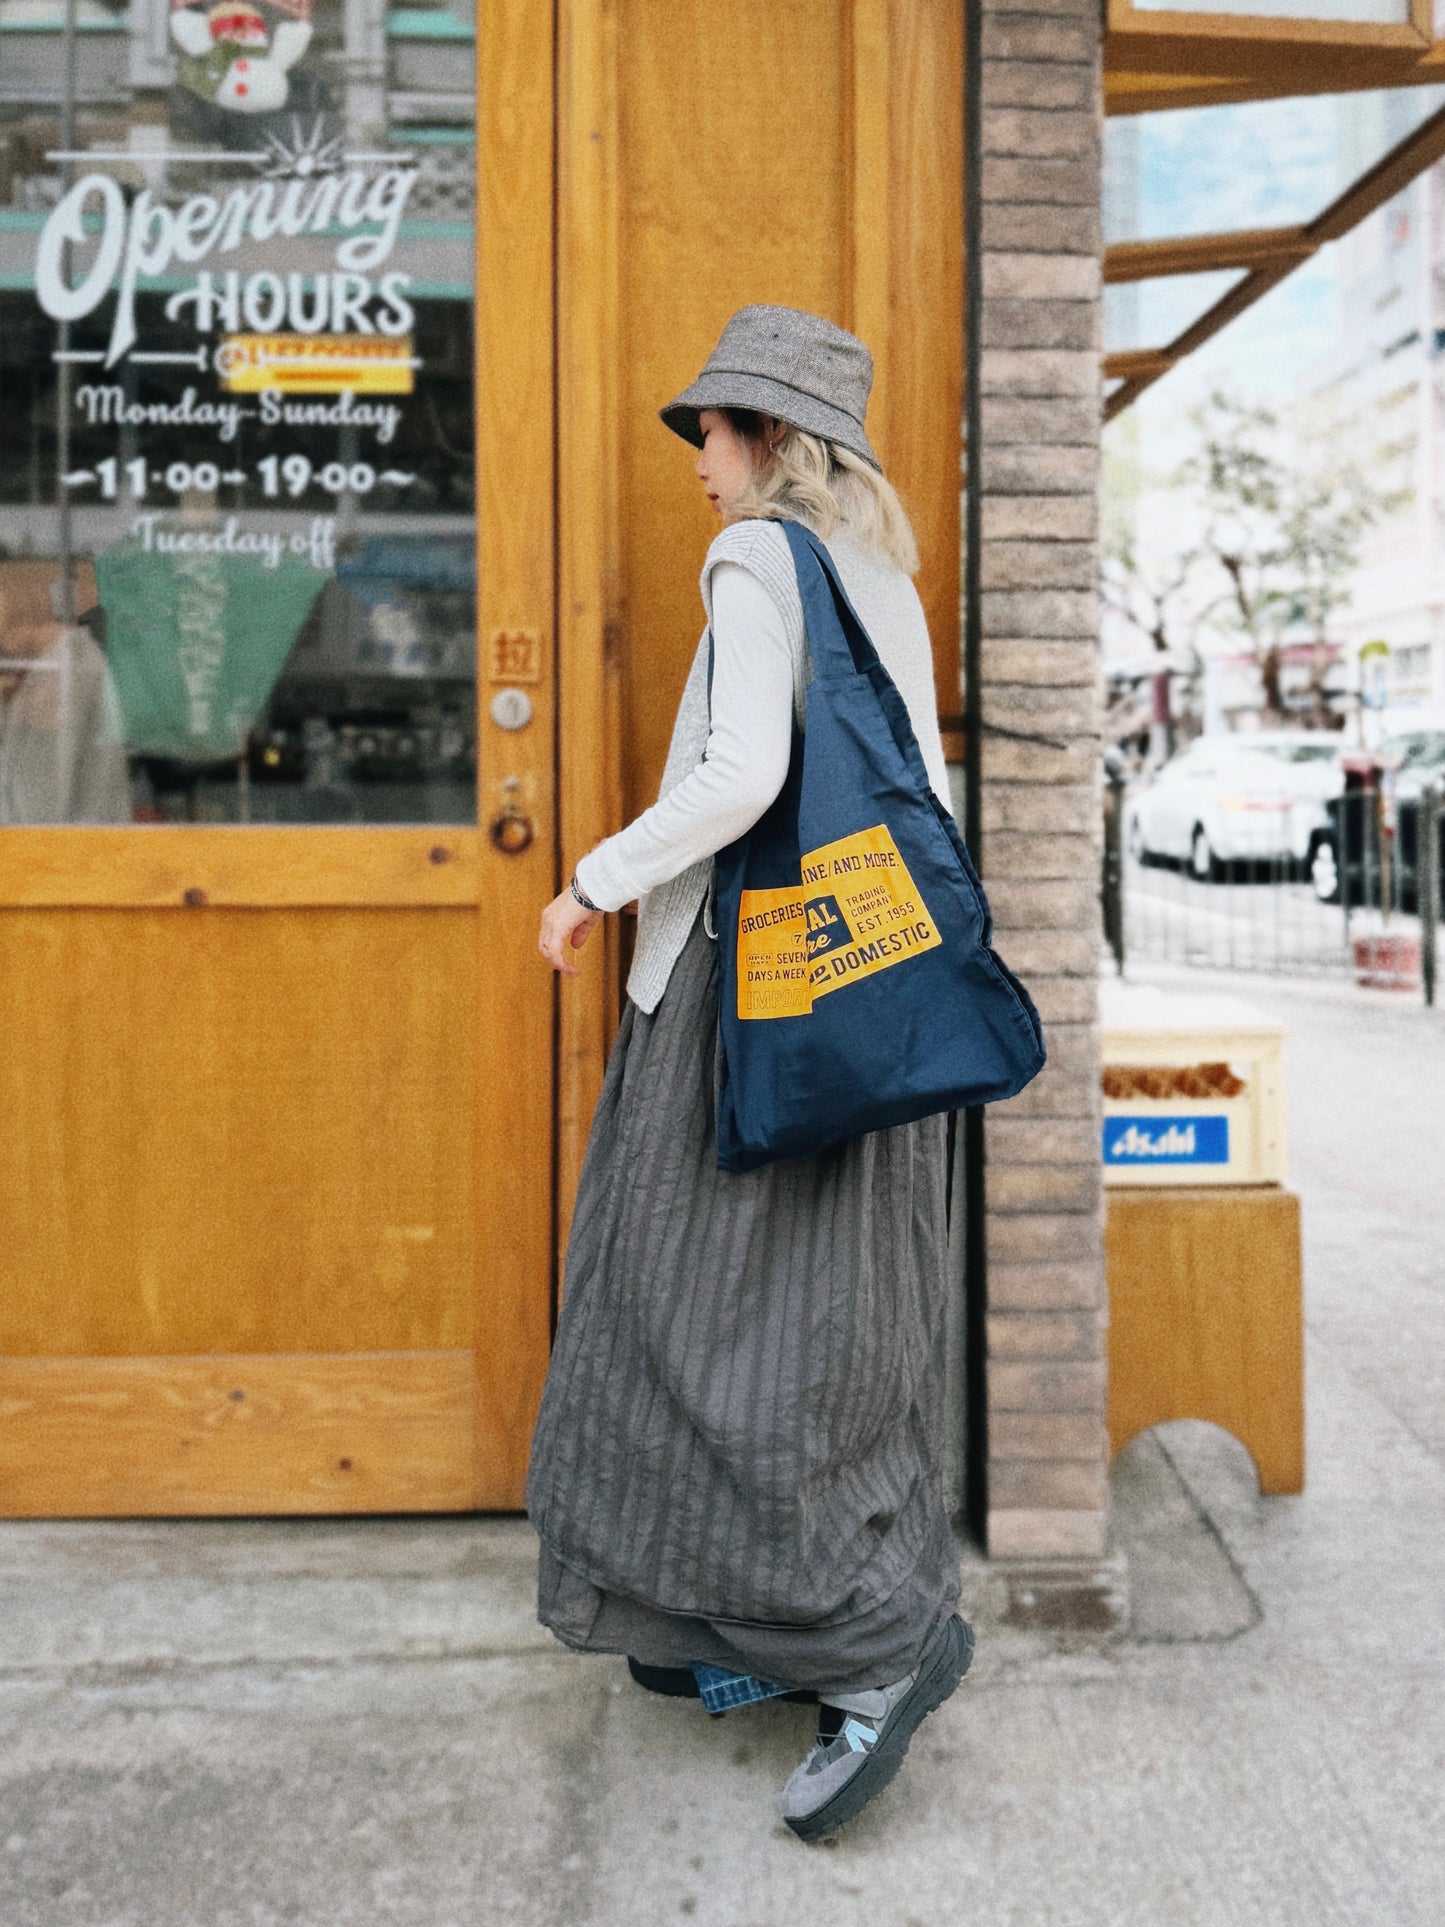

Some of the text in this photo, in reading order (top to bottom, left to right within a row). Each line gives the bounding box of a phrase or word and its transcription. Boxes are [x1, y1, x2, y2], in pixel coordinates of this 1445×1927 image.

[36, 166, 419, 370] Opening
[165, 270, 414, 335] HOURS
[133, 512, 336, 569] Tuesday off
[863, 852, 900, 869] MORE.
[846, 885, 886, 907] TRADING
[850, 893, 893, 918] COMPANY
[741, 901, 804, 934] GROCERIES
[776, 952, 807, 965] SEVEN
[831, 921, 930, 976] DOMESTIC
[747, 970, 773, 982] DAYS
[774, 969, 781, 981] A
[782, 968, 807, 980] WEEK
